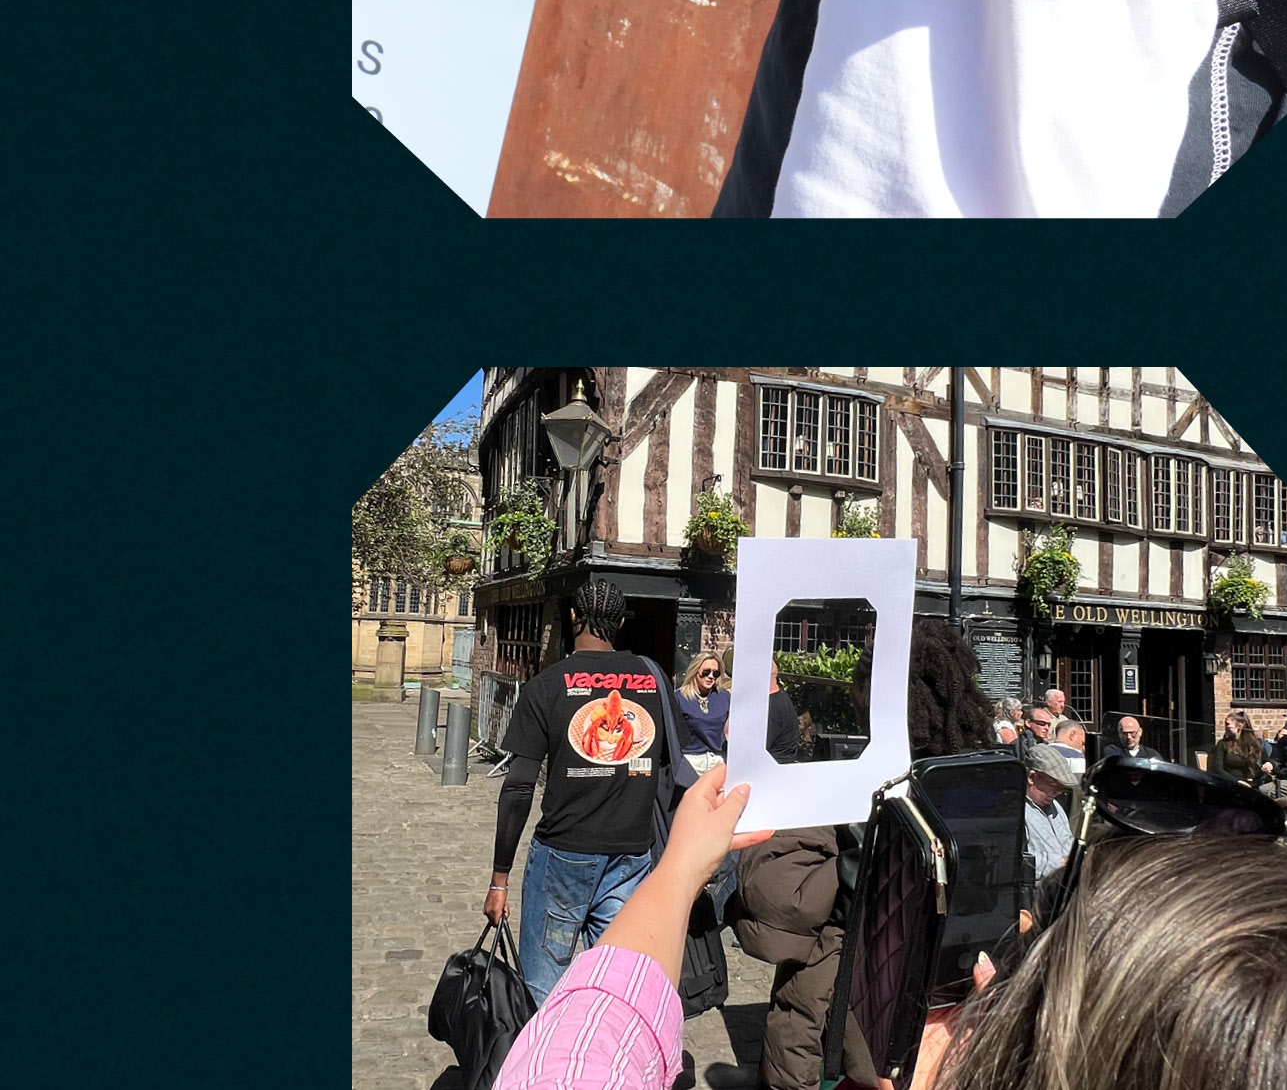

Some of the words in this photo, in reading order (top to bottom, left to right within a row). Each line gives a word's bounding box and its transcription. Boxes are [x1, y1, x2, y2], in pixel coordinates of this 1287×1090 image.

[357, 39, 384, 76] S
[1073, 605, 1108, 622] OLD
[1115, 608, 1220, 629] WELLINGTON
[564, 672, 657, 689] vacanza
